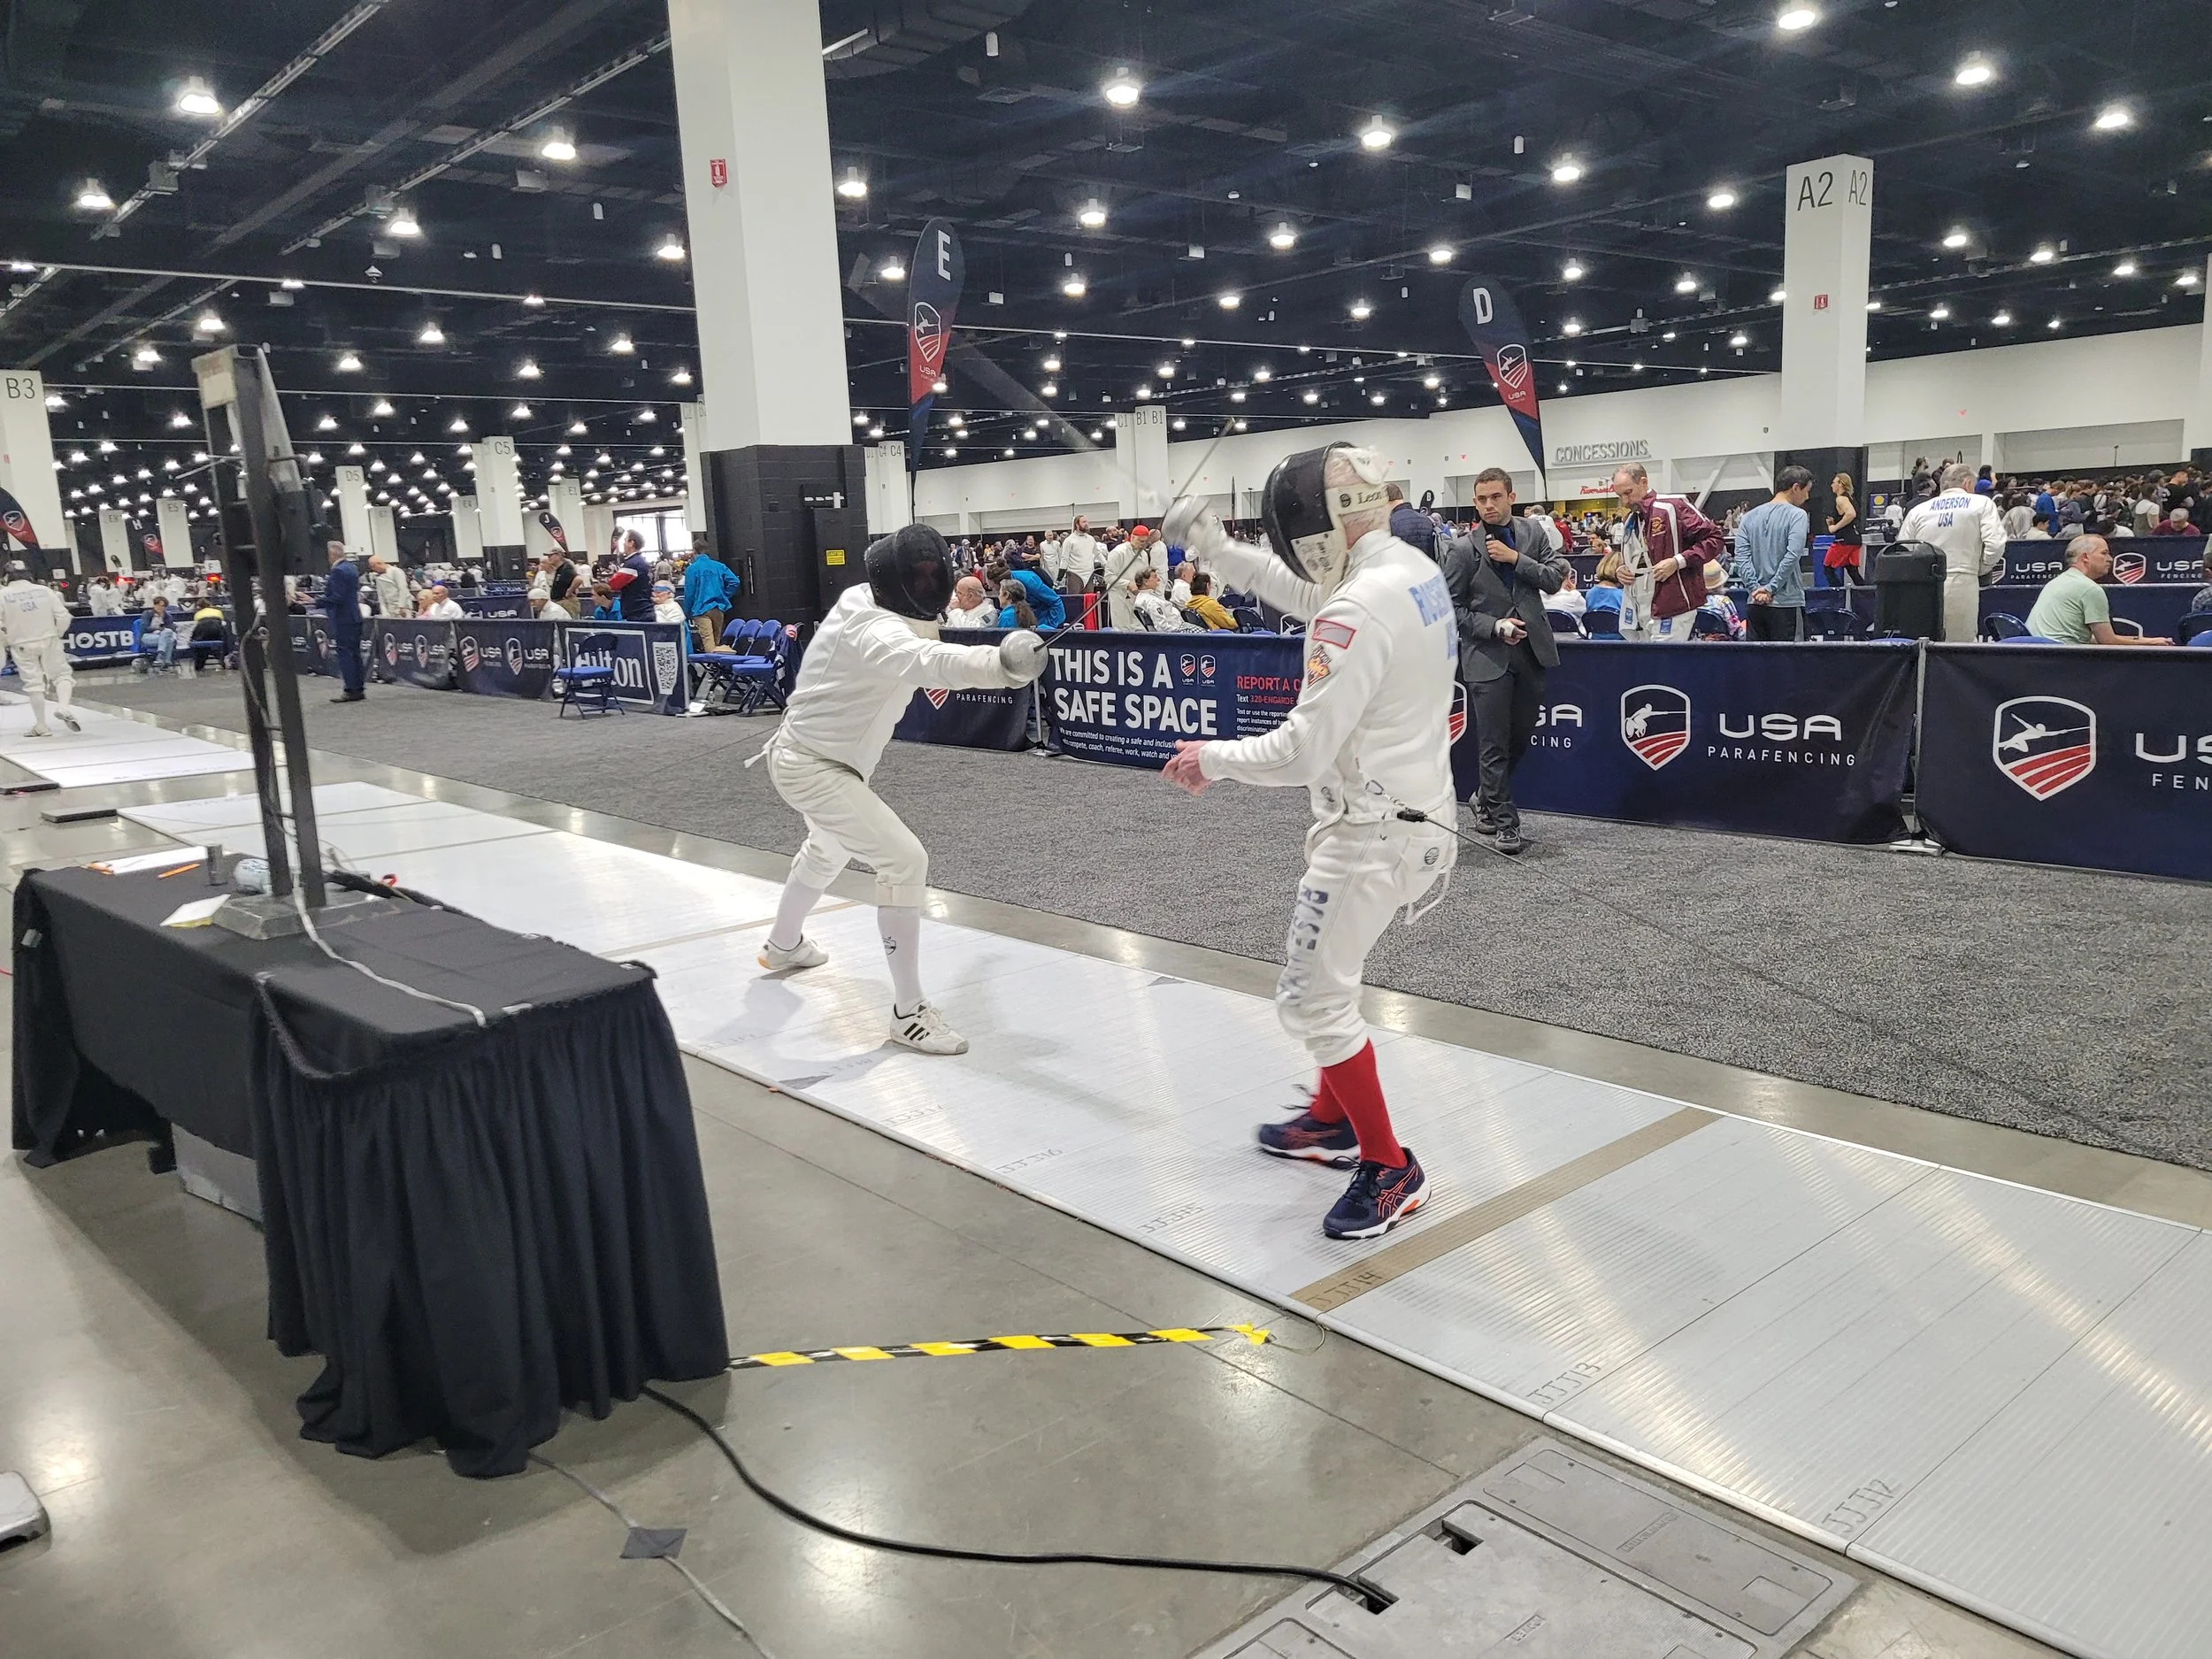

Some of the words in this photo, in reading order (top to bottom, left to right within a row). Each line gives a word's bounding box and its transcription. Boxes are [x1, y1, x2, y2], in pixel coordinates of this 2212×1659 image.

[1797, 171, 1833, 211] A2
[1848, 169, 1868, 205] A2
[937, 229, 951, 280] E
[1472, 287, 1494, 325] D
[919, 365, 937, 378] USA
[6, 377, 35, 399] B3
[1508, 390, 1526, 400] USA
[1136, 411, 1147, 426] B1
[1152, 410, 1164, 424] B1
[495, 442, 511, 455] C5
[890, 444, 902, 457] C4
[1556, 439, 1648, 462] CONCESSIONS
[1930, 496, 1971, 511] ANDERSON
[1938, 511, 1954, 526] USA
[2016, 561, 2062, 572] USA
[2156, 560, 2204, 572] USA
[488, 610, 518, 618] USA
[524, 648, 549, 660] USA
[1048, 648, 1110, 684] THIS
[1118, 651, 1143, 687] IS
[1152, 653, 1173, 689] A
[1236, 675, 1280, 690] REPORT
[1282, 678, 1290, 691] A
[956, 693, 1013, 704] PARAFENCING
[1236, 694, 1248, 703] Text
[1054, 687, 1117, 726] SAFE
[1125, 694, 1217, 736] SPACE
[1719, 712, 1842, 741] USA
[1072, 730, 1098, 740] committed
[1105, 735, 1125, 745] creating
[1155, 740, 1176, 749] inclusiv
[1531, 734, 1571, 749] CING
[1105, 746, 1124, 755] referee,
[1708, 745, 1856, 766] PARAFENCING
